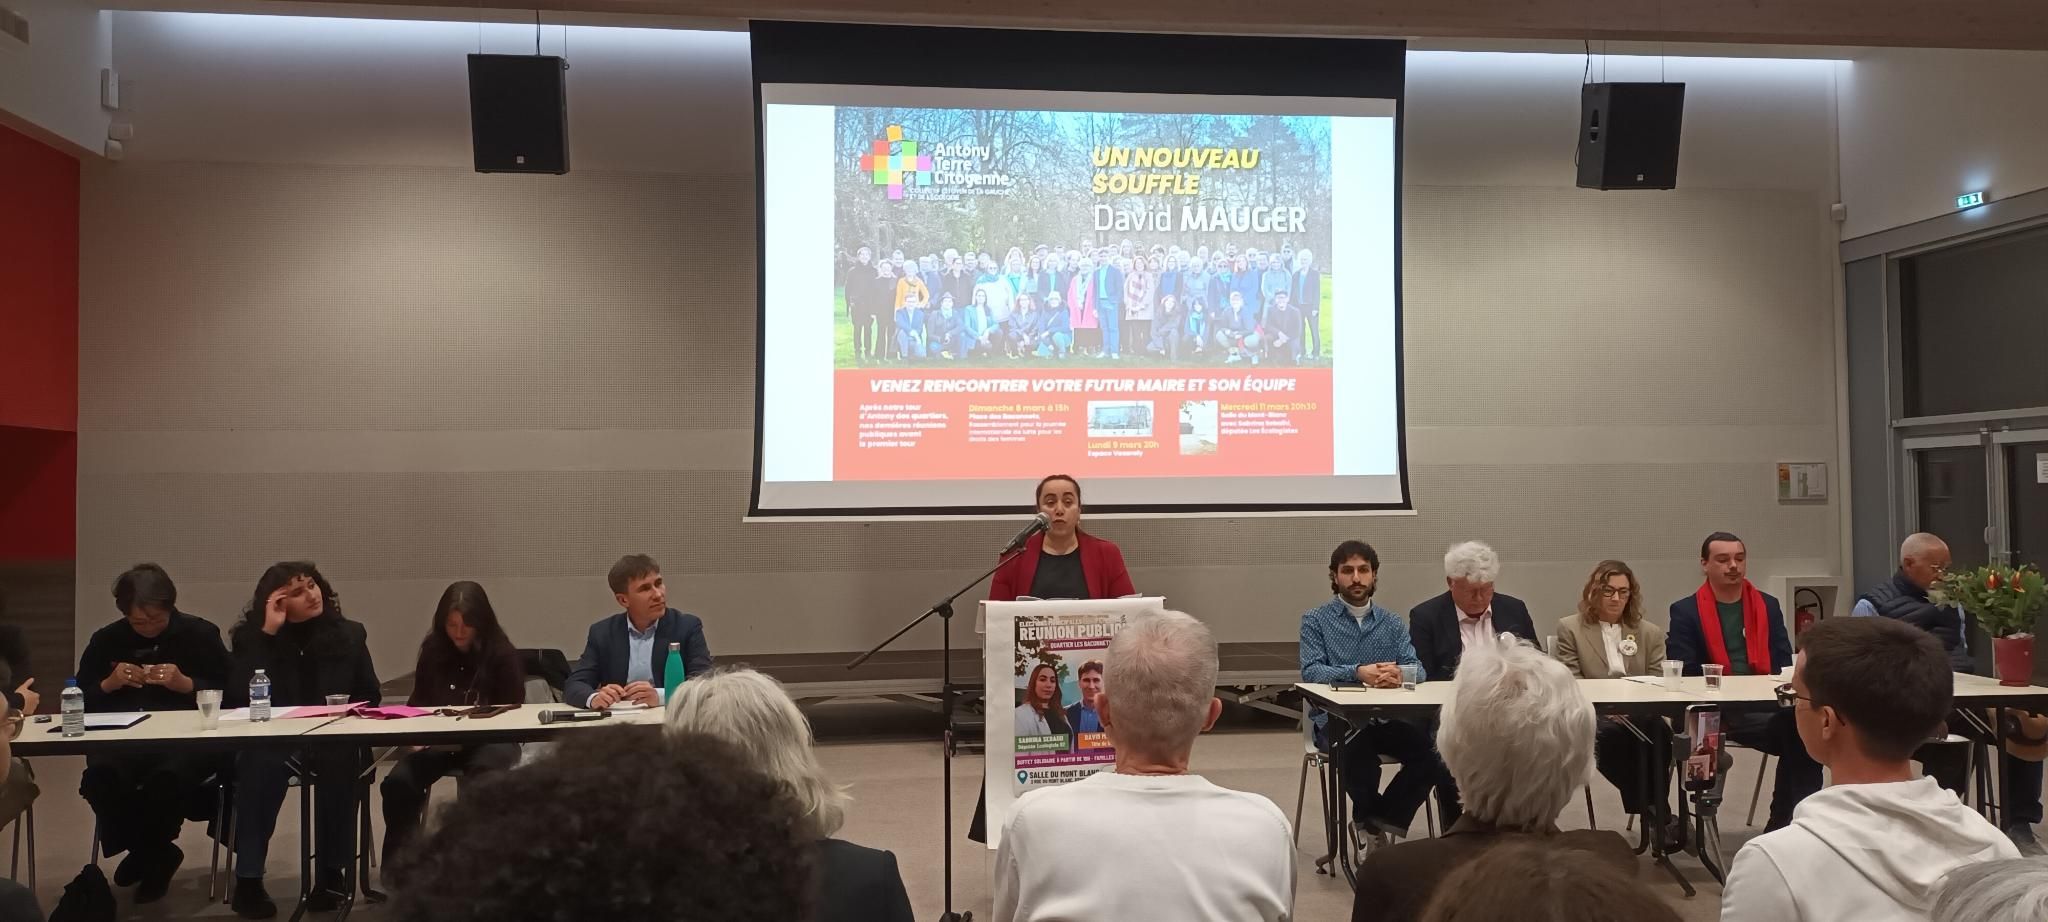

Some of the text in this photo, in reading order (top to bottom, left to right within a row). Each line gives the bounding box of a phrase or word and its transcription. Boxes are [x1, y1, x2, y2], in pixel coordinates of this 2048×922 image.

[935, 142, 990, 161] Antony
[1092, 146, 1260, 169] UN NOUVEAU
[935, 156, 972, 171] Terre
[934, 170, 1009, 188] Citoyenne
[1092, 173, 1201, 195] SOUFFLE
[1094, 203, 1307, 233] David MAUGER
[870, 374, 1296, 393] VENEZ RENCONTRER VOTRE FUTUR MAIRE ET SON ÉQUIPE
[859, 403, 882, 413] Après
[968, 404, 1014, 412] Dimanche
[1220, 402, 1258, 411] Mercredi
[1266, 403, 1289, 411] mars
[859, 431, 898, 439] publiques
[867, 440, 898, 448] premier
[1087, 440, 1112, 449] Lundi
[1143, 440, 1160, 449] 20h
[1050, 639, 1112, 649] QUARTIER LES BACONNET
[1084, 733, 1101, 741] DAVID
[1029, 771, 1049, 779] SALLE
[1050, 770, 1059, 778] DU
[1060, 769, 1078, 778] MONT
